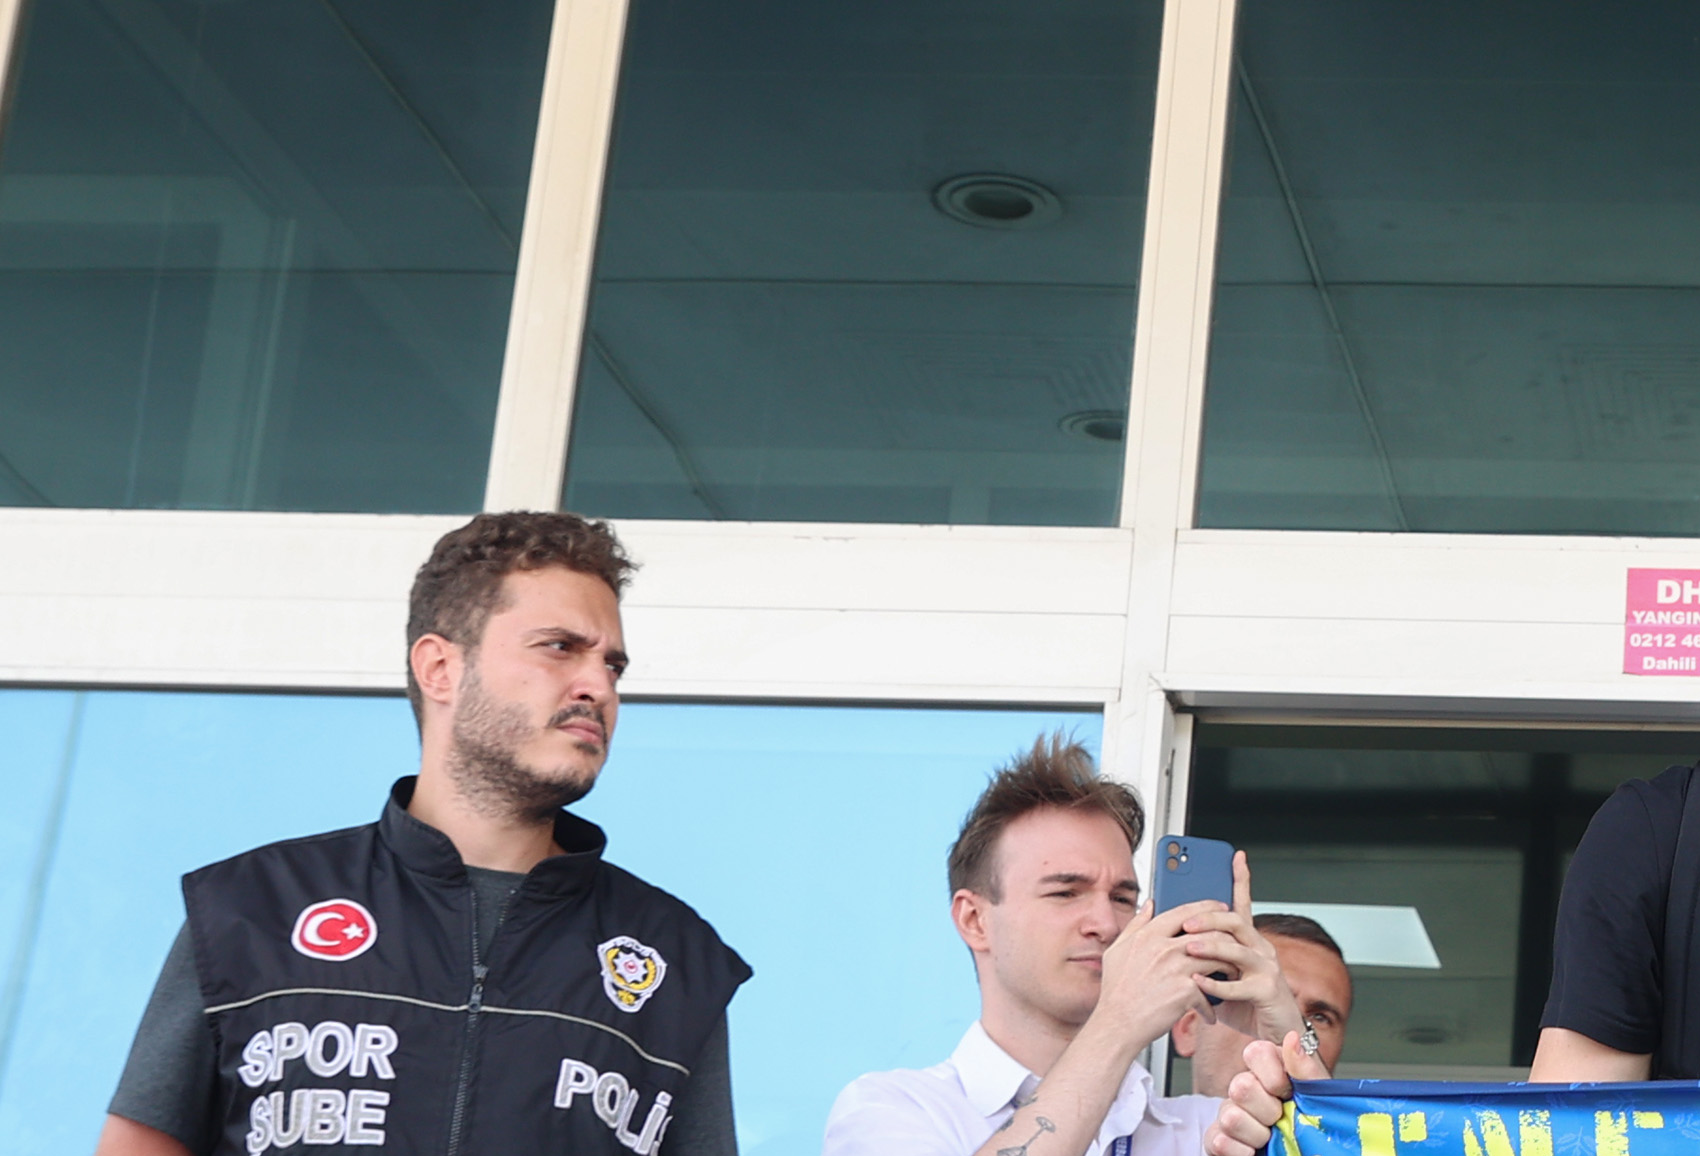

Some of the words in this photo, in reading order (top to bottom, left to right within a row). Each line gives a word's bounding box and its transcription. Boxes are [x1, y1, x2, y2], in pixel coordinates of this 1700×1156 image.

[1630, 633, 1676, 648] 0212
[1642, 657, 1696, 670] Dahili
[237, 1021, 399, 1087] SPOR
